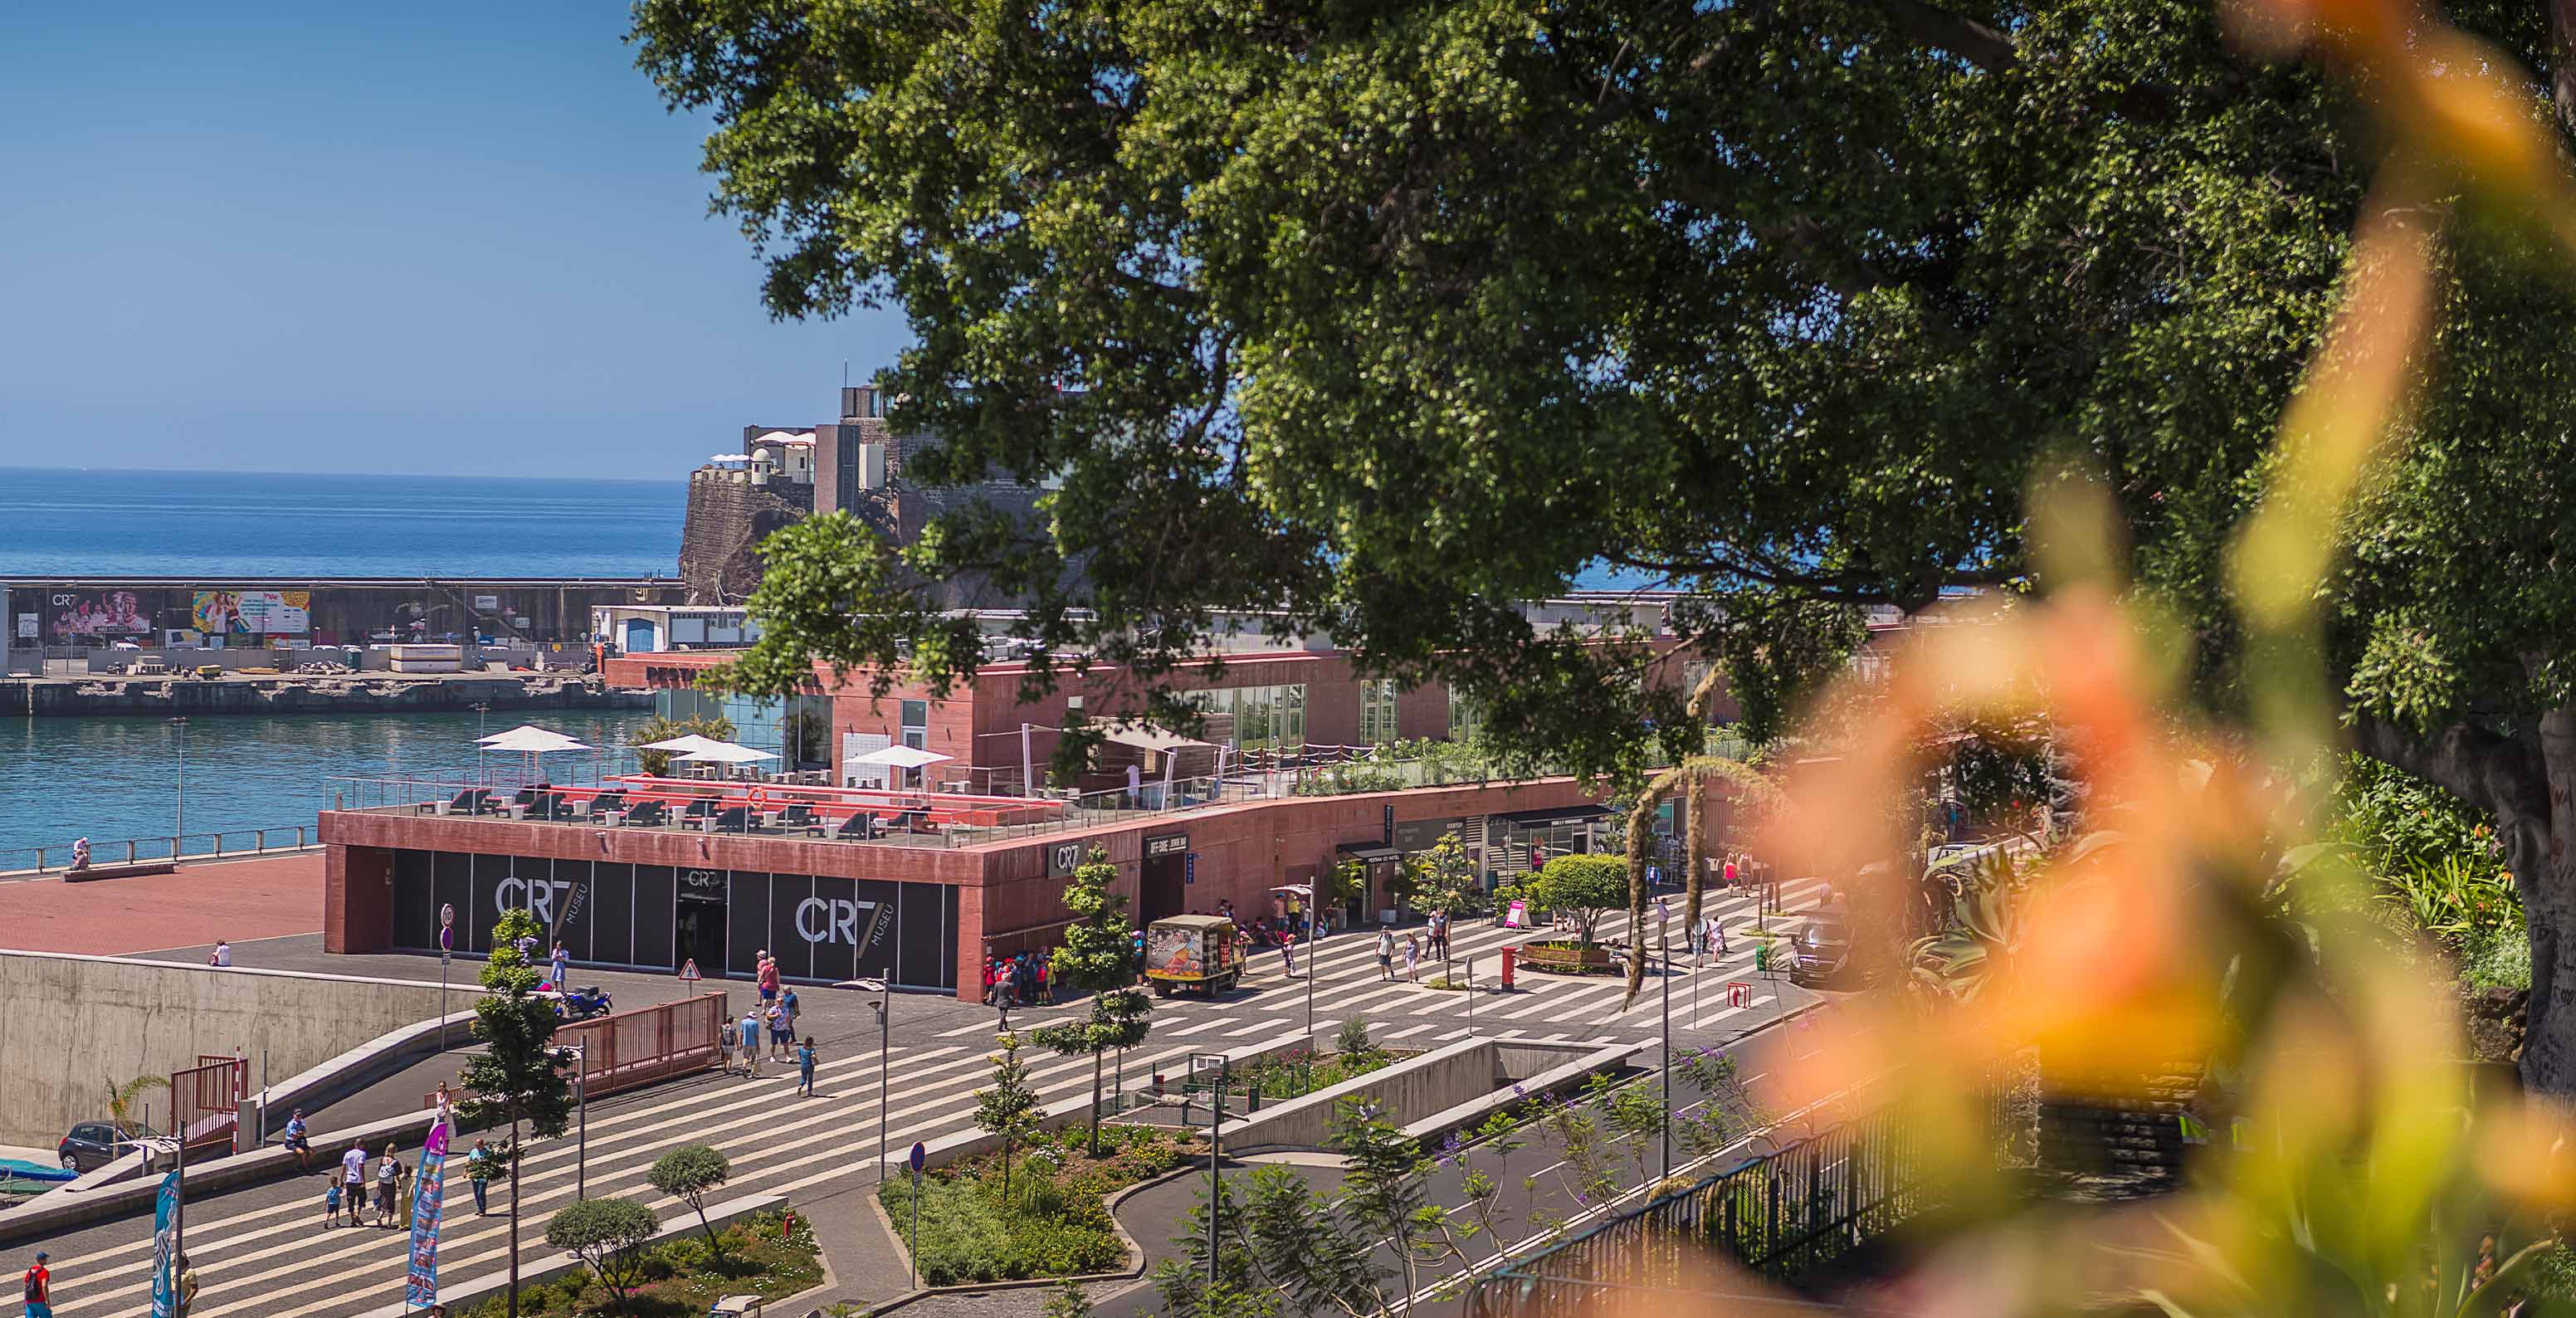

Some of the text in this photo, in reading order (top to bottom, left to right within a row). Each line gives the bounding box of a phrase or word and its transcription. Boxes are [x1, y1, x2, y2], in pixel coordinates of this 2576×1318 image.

[53, 594, 79, 608] CR7
[1058, 845, 1079, 873] CR7
[495, 877, 578, 936] CR7
[566, 883, 588, 925] MUSEU
[871, 904, 895, 946] MUSEU
[796, 897, 884, 959] CR7
